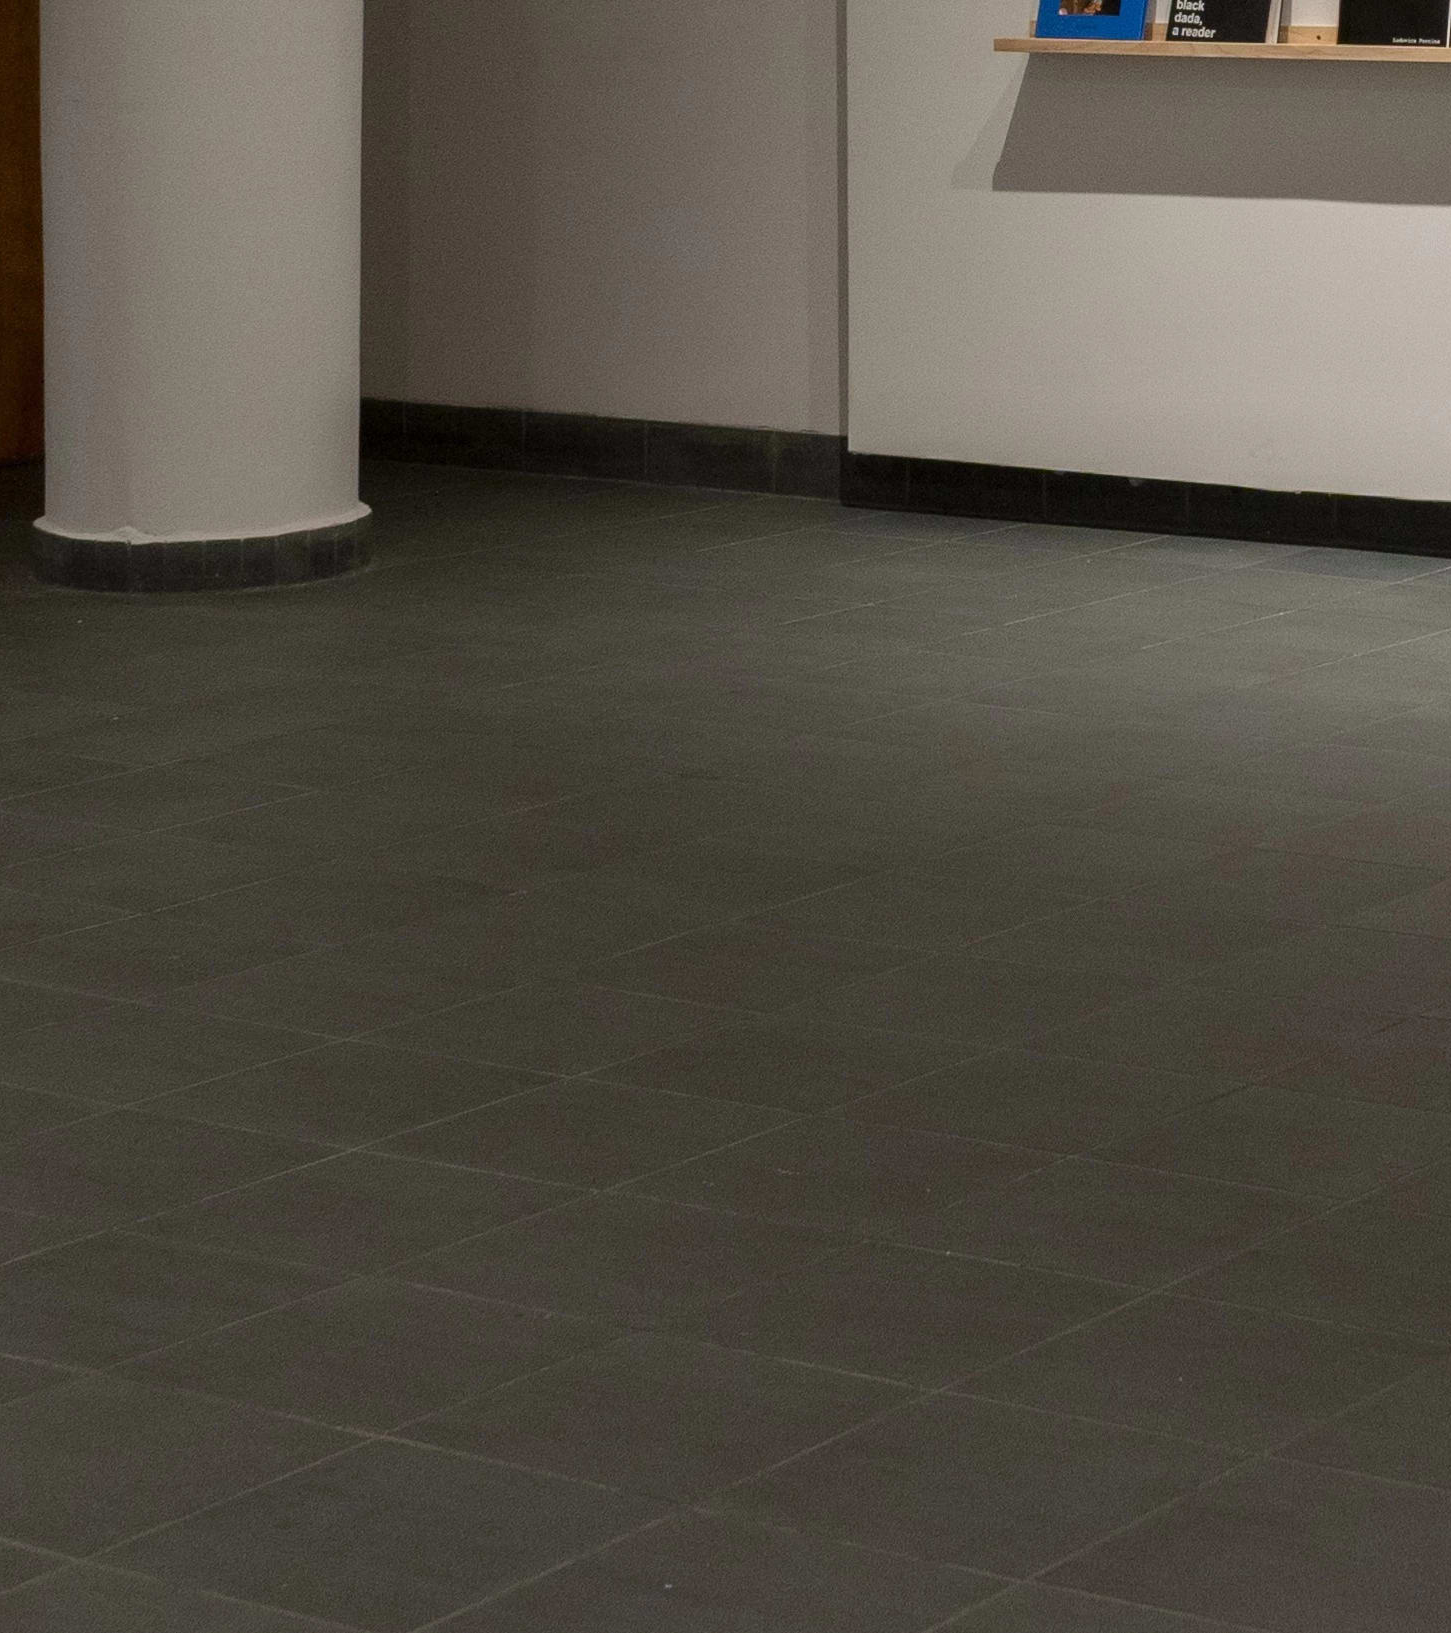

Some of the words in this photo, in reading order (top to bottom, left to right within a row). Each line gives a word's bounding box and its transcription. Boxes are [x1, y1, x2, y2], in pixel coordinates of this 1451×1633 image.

[1176, 0, 1205, 11] black
[1174, 12, 1203, 26] dada,
[1171, 26, 1179, 36] a
[1181, 26, 1217, 39] reader
